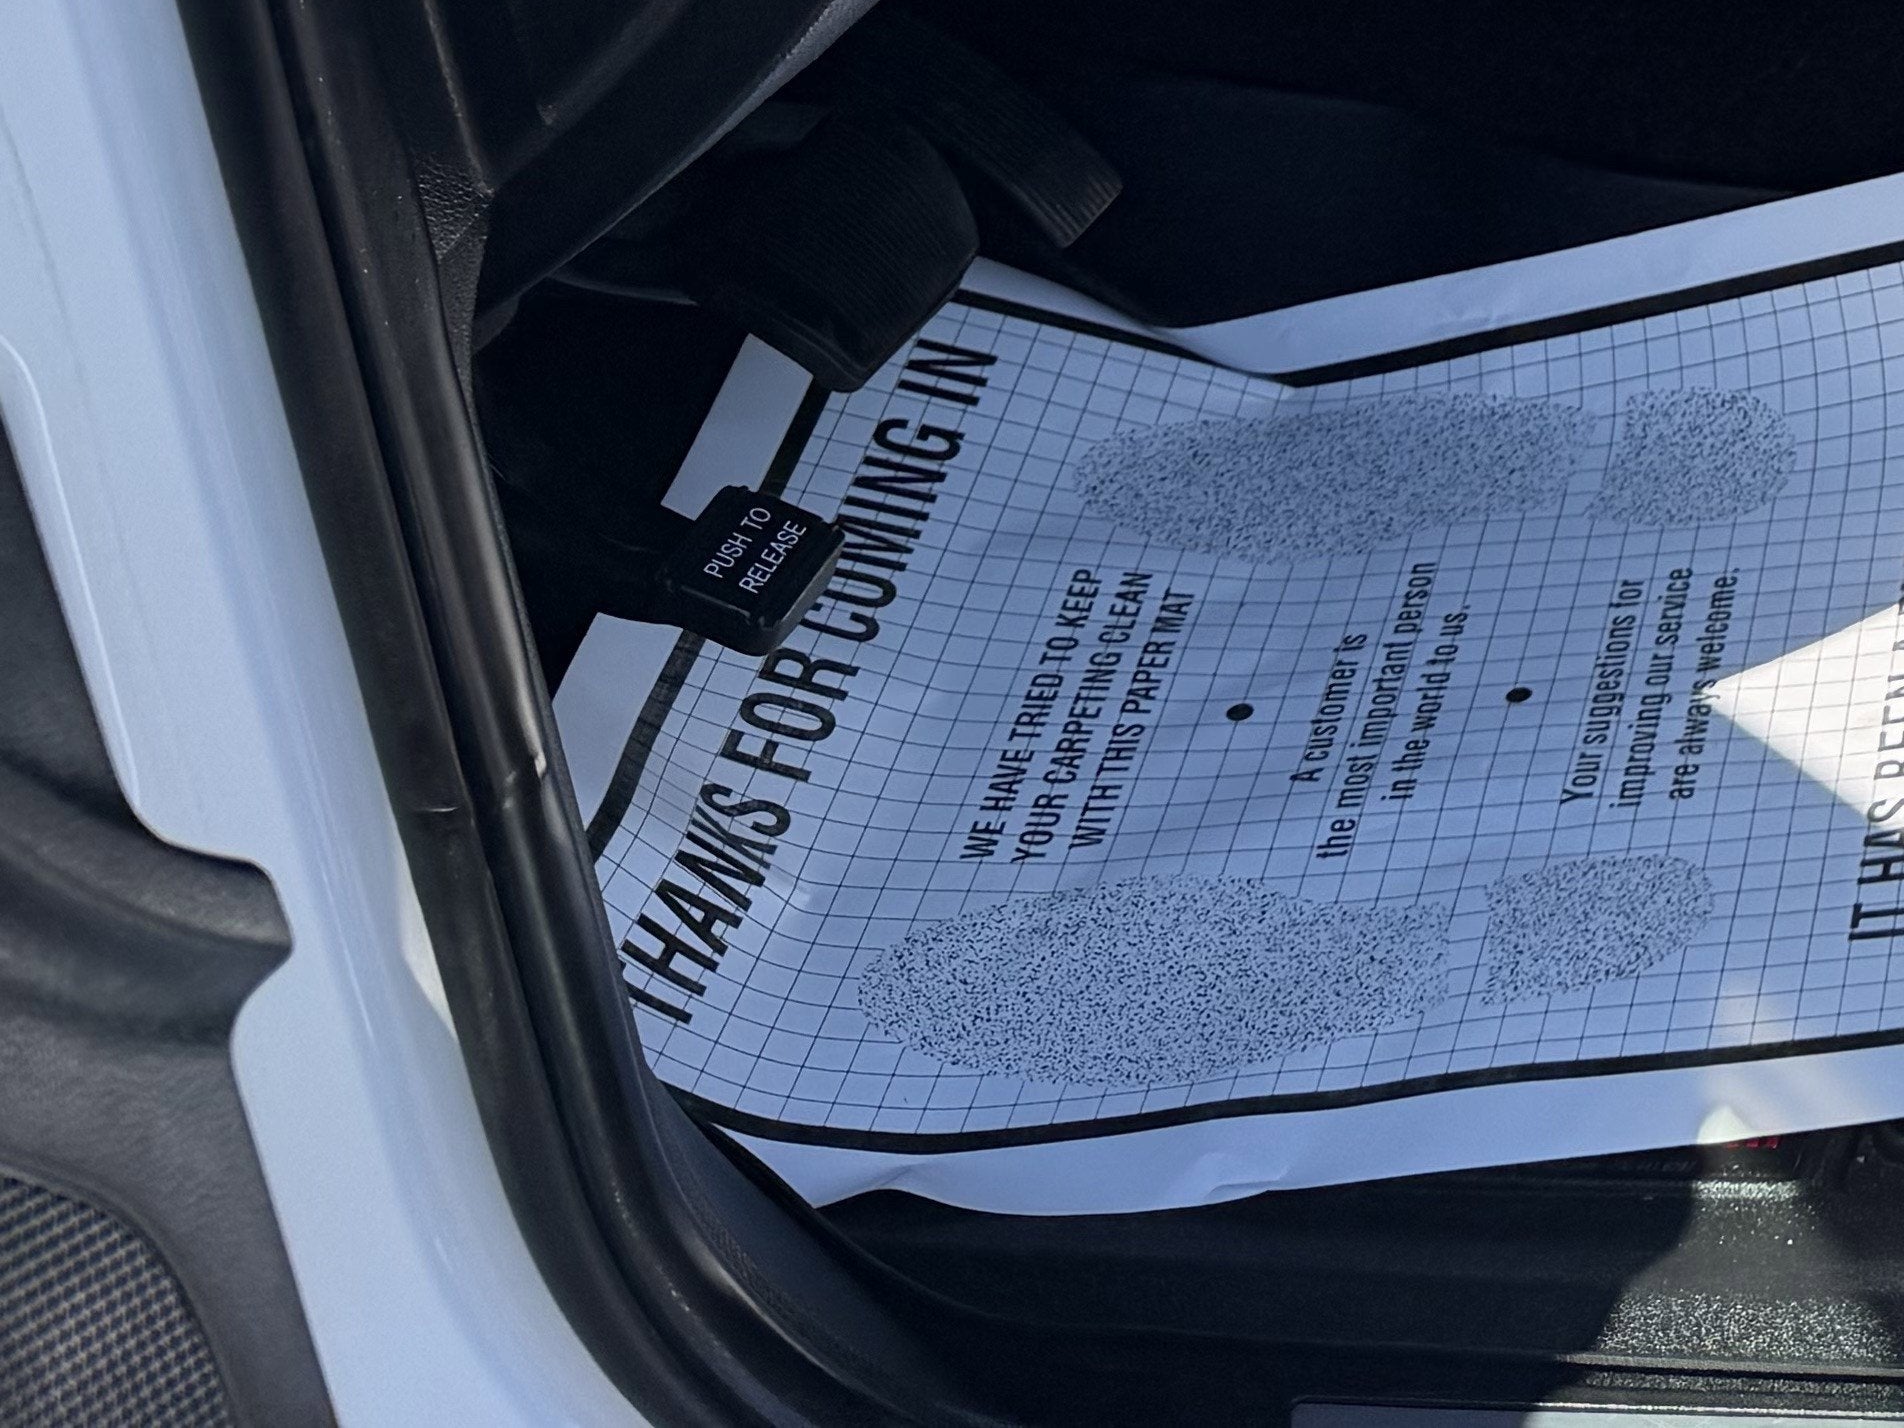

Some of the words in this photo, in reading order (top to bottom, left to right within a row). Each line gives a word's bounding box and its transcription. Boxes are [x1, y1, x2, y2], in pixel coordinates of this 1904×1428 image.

[703, 532, 753, 578] PUSH
[740, 507, 771, 530] TO
[738, 520, 807, 594] RELEASE
[1055, 568, 1102, 630] KEEP
[1151, 588, 1195, 635] MAT
[1394, 560, 1438, 635] person
[1443, 604, 1472, 636] us.
[1609, 579, 1644, 610] for
[1655, 567, 1694, 646] service
[1695, 567, 1740, 674] welcome.
[1039, 636, 1080, 665] TO
[1333, 632, 1368, 655] is
[1427, 642, 1460, 667] to
[1645, 651, 1674, 687] our
[618, 782, 793, 1024] THANKS
[721, 647, 861, 782] FOR
[802, 417, 965, 644] COMING
[897, 337, 999, 407] IN
[1008, 673, 1064, 742] TRIED
[1121, 641, 1176, 714] PAPER
[1351, 641, 1414, 748] important
[1412, 670, 1451, 732] world
[1583, 613, 1636, 746] suggestions
[1010, 793, 1069, 864] YOUR
[1043, 651, 1122, 785] CARPETING
[1098, 571, 1153, 644] CLEAN
[1304, 658, 1359, 762] customer
[1672, 680, 1721, 756] always
[1099, 722, 1145, 775] THIS
[1289, 766, 1324, 783] A
[1337, 750, 1377, 809] most
[1391, 738, 1430, 772] the
[1560, 751, 1603, 805] Your
[1608, 691, 1672, 809] improving
[980, 749, 1035, 812] HAVE
[1380, 779, 1418, 801] in
[1668, 763, 1700, 801] are
[959, 820, 1007, 860] WE
[1068, 783, 1123, 849] WITH
[1316, 818, 1356, 860] the
